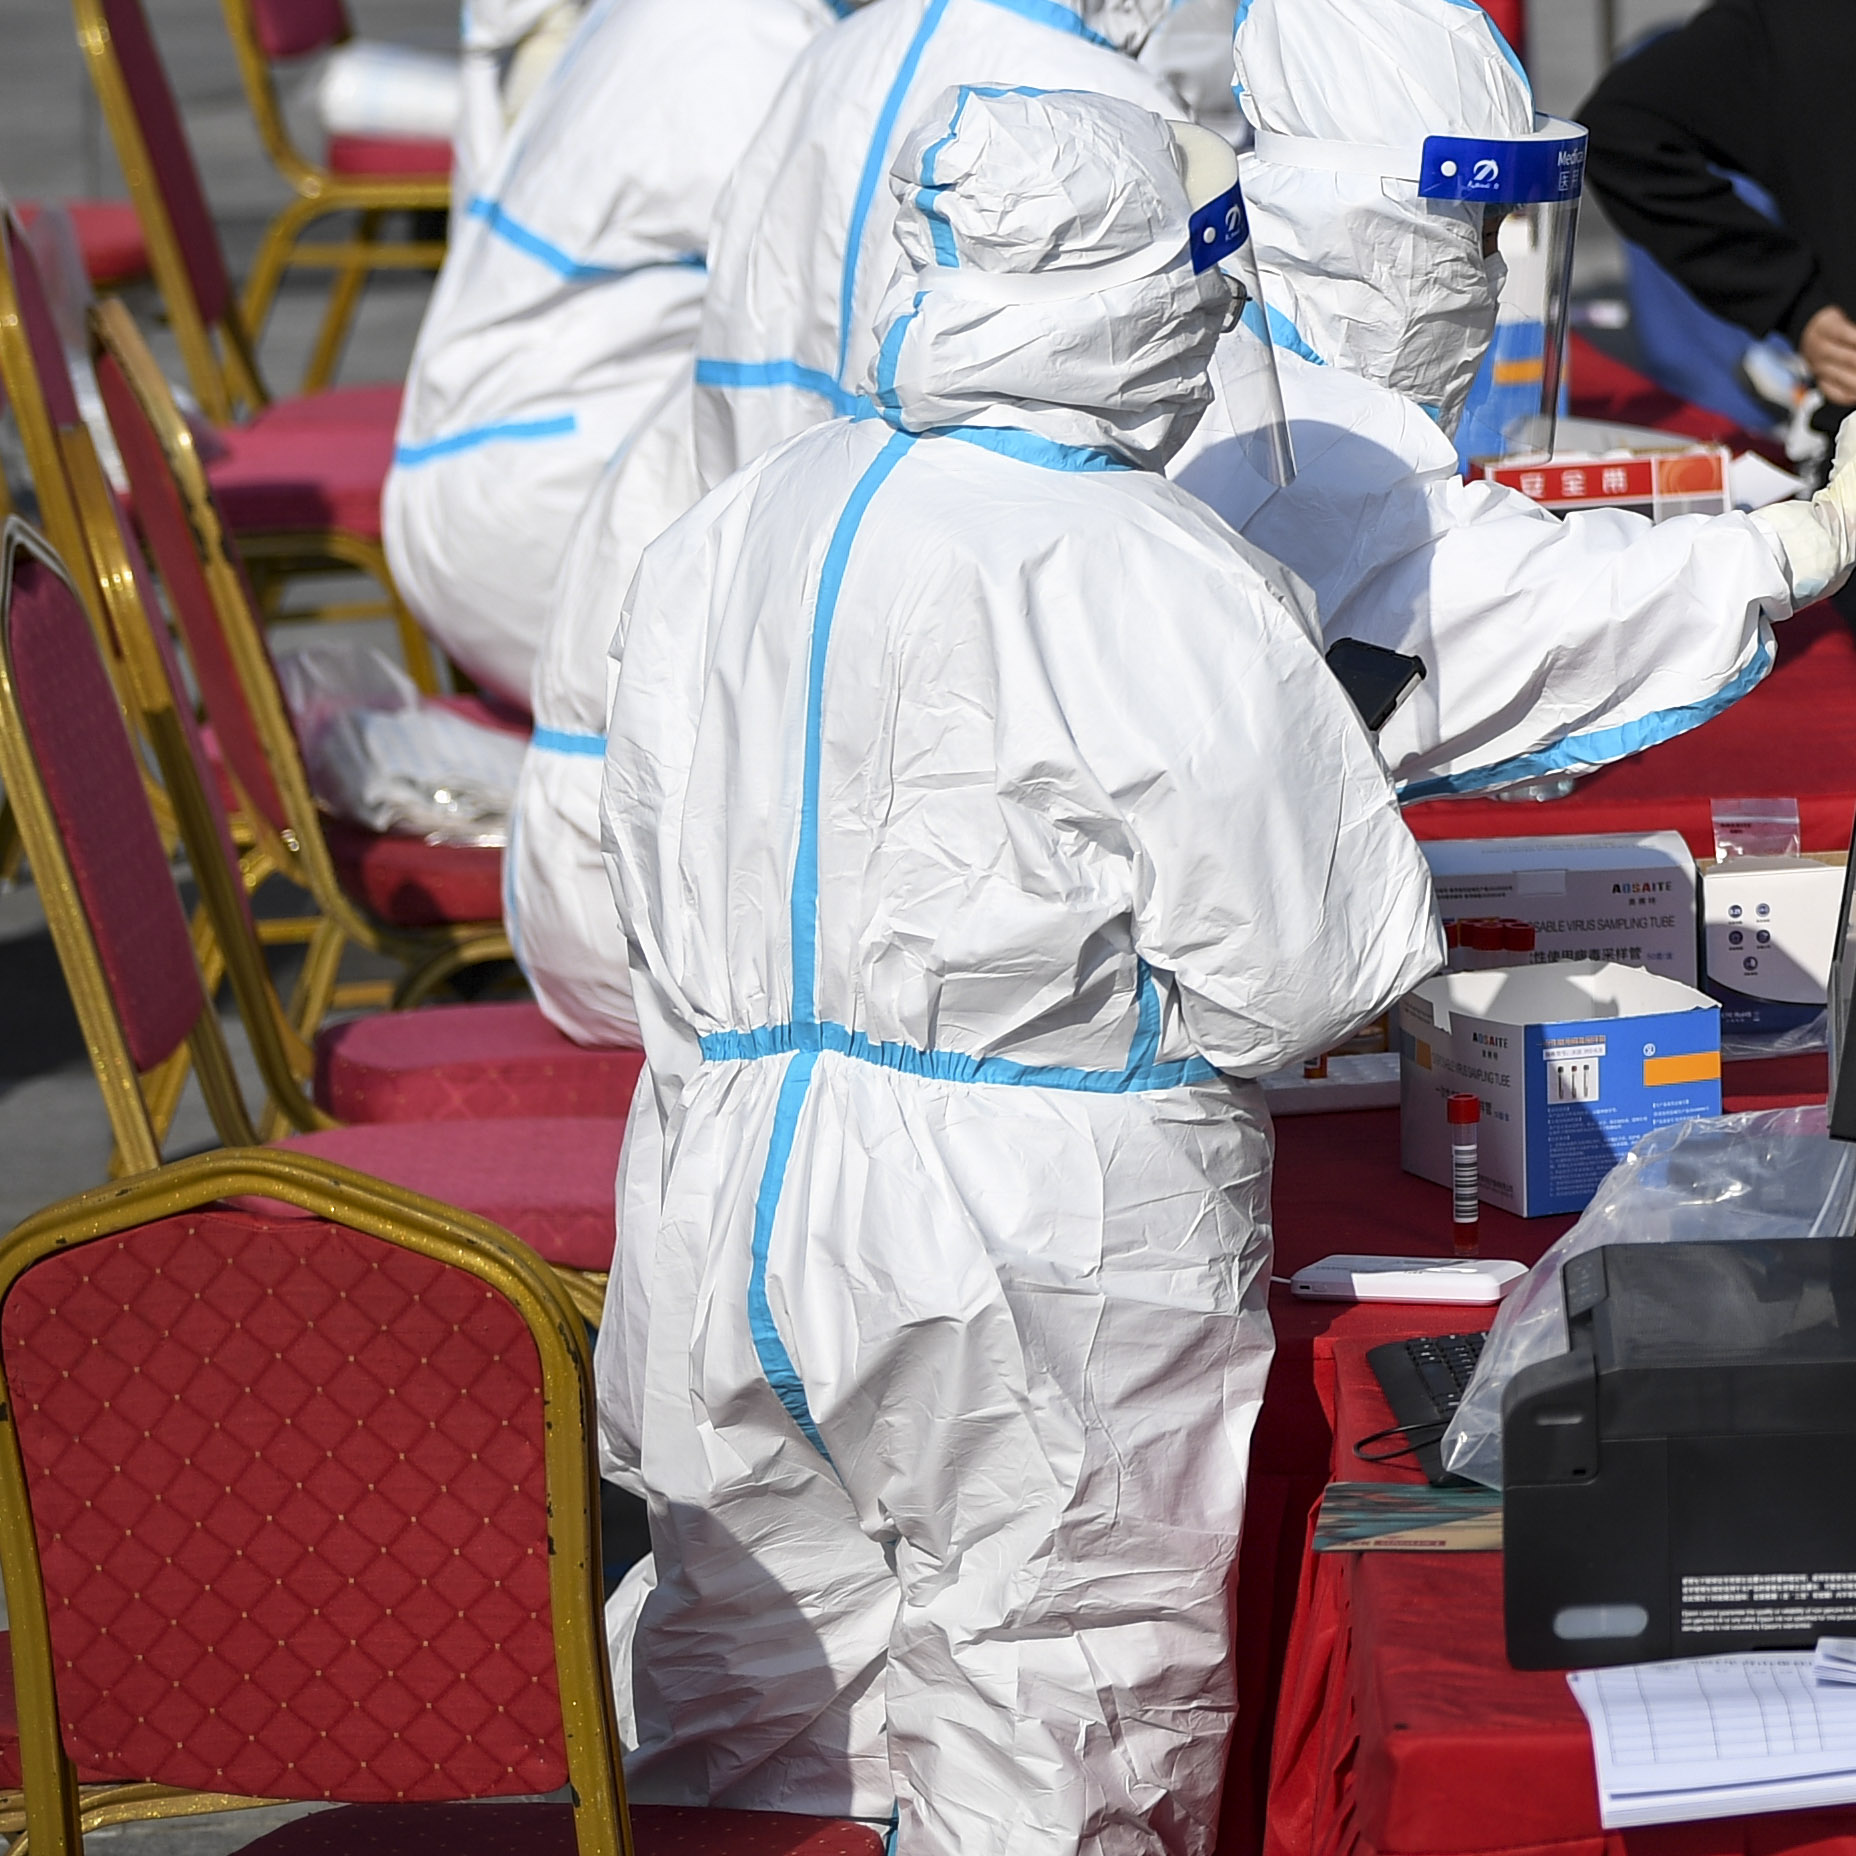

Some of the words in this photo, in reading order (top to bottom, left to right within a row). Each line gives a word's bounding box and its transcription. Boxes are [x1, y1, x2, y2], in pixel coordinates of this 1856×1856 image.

[1567, 918, 1596, 932] VIRUS
[1597, 917, 1648, 931] SAMPLING
[1650, 916, 1676, 928] TUBE
